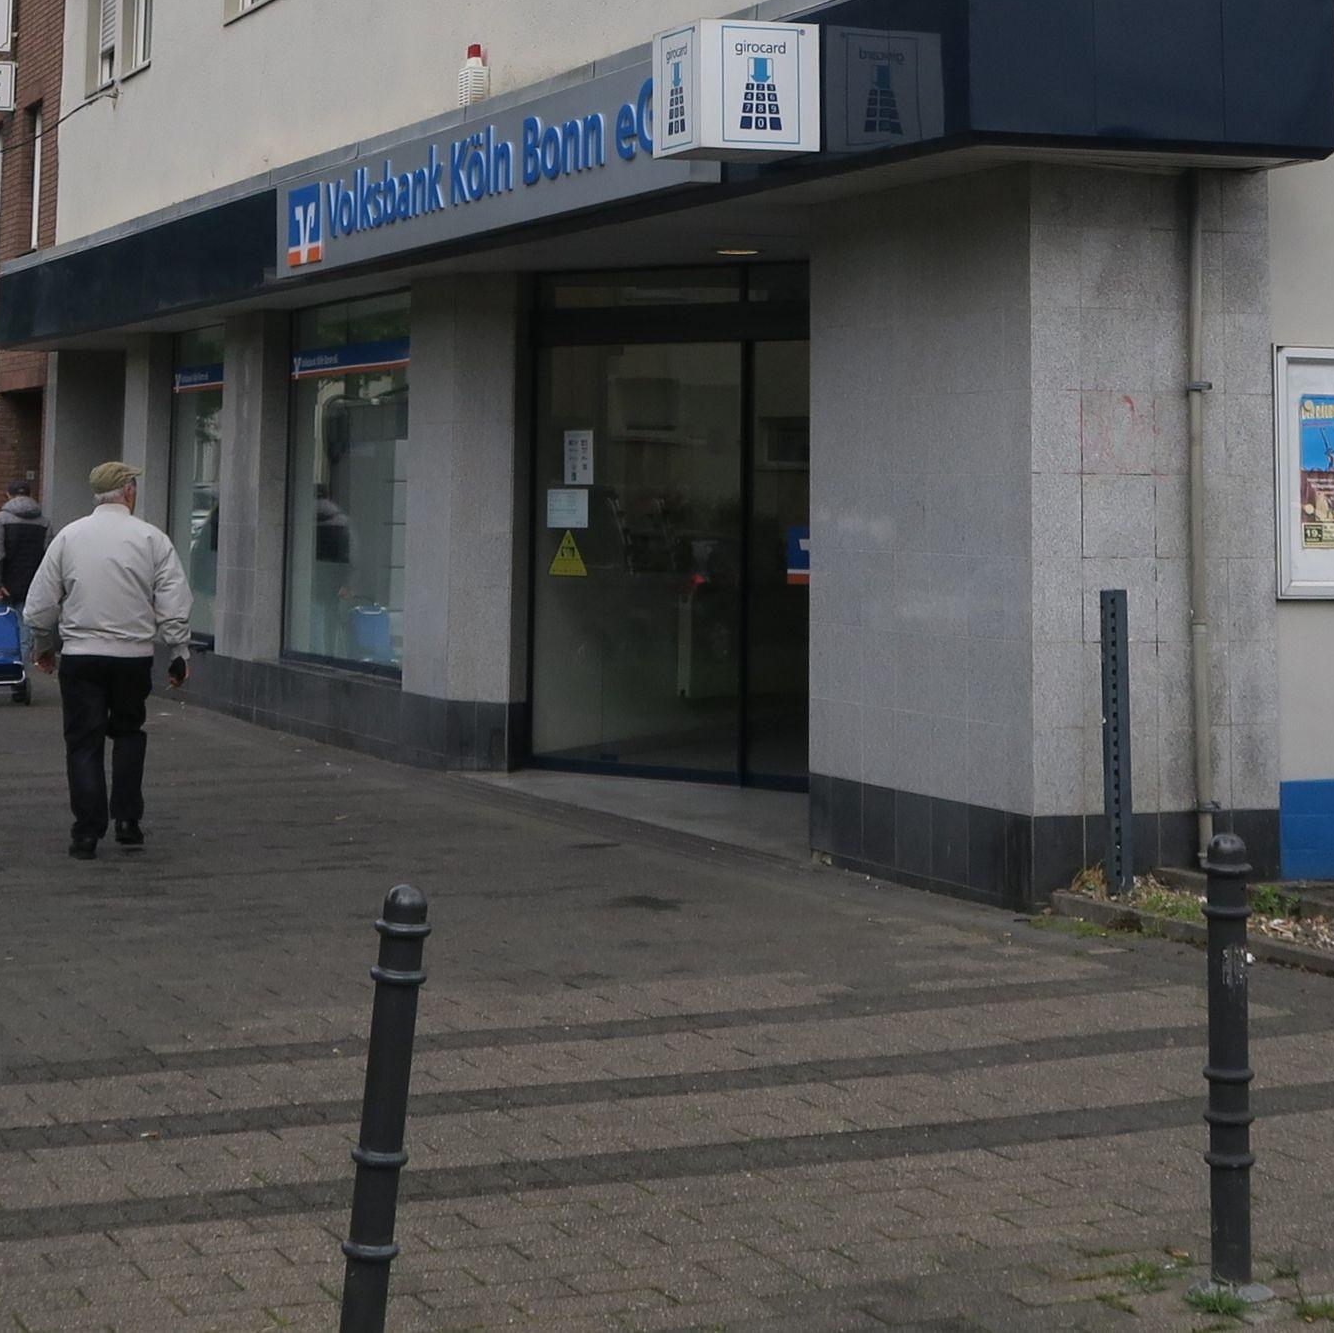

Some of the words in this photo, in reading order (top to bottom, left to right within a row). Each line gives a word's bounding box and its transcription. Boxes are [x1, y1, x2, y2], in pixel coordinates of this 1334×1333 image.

[734, 40, 787, 56] girocard
[326, 144, 445, 239] Volksbank
[450, 125, 514, 206] Köln
[523, 113, 605, 186] Bonn
